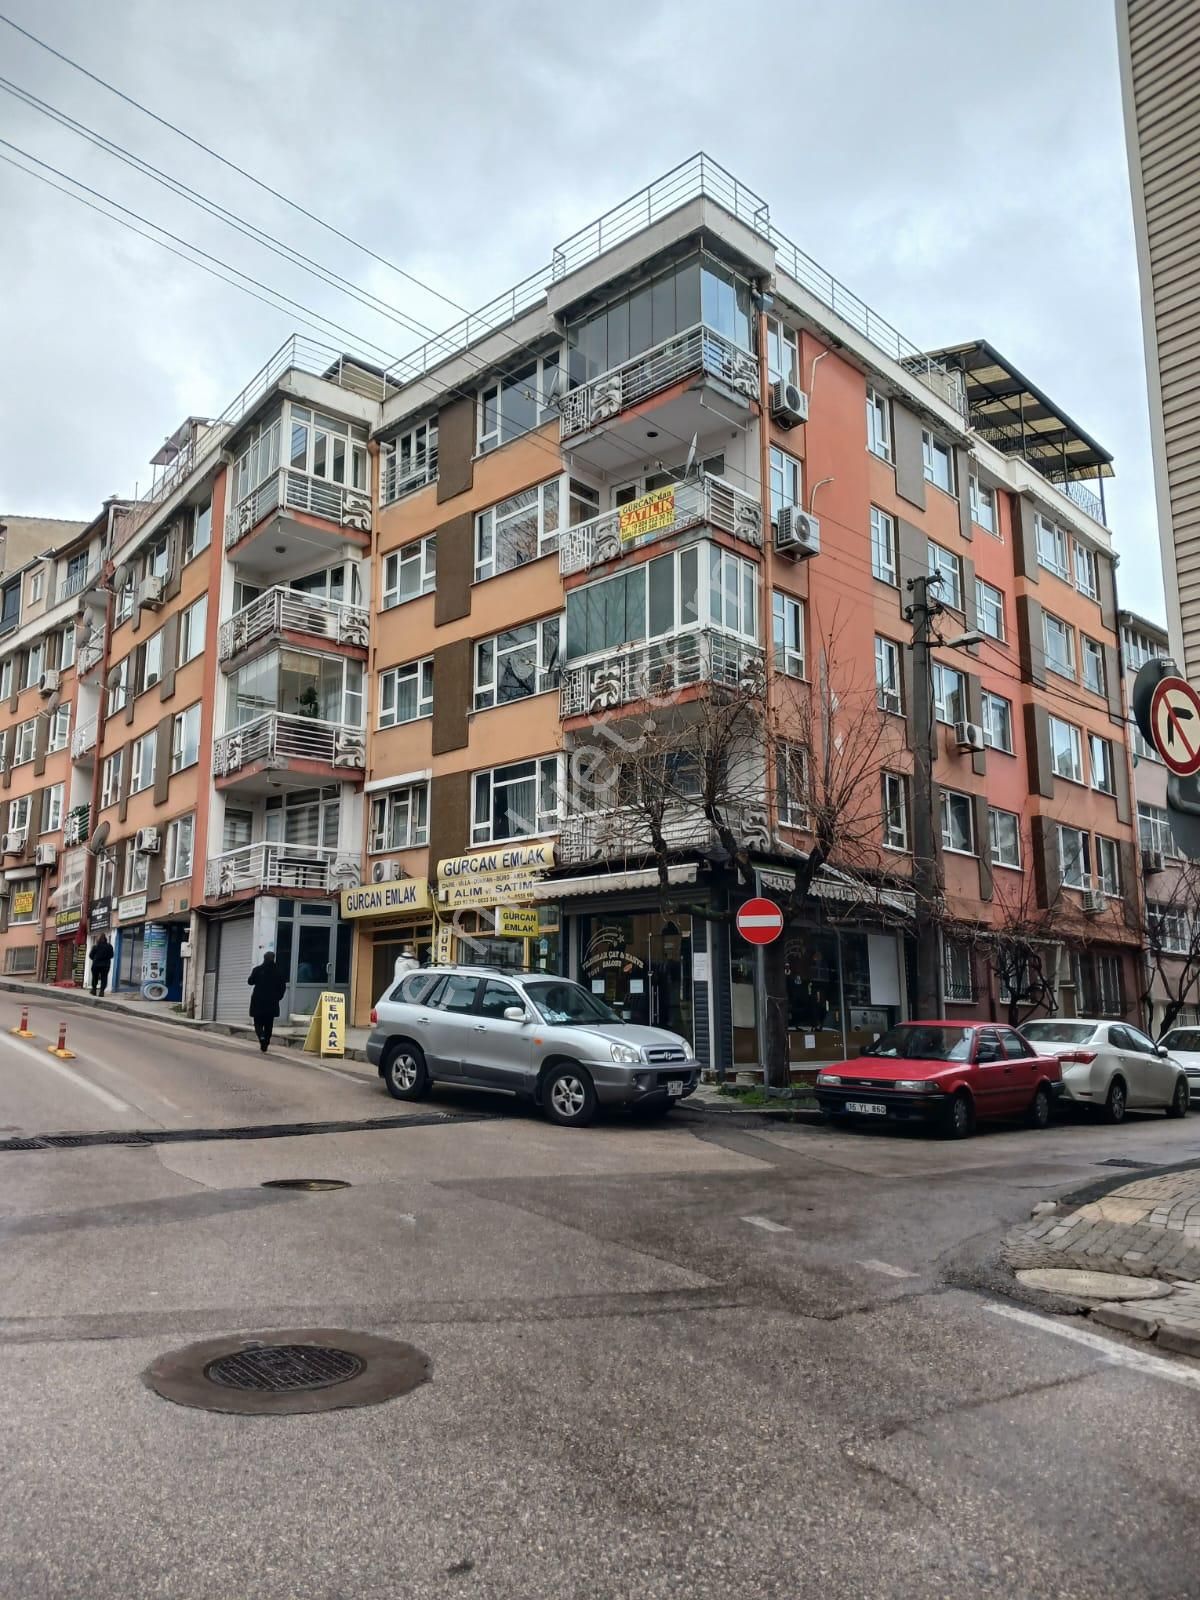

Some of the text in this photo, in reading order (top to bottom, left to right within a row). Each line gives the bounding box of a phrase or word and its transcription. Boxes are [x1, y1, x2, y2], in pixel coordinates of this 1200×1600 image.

[620, 497, 674, 527] SATILIK
[443, 847, 545, 876] GÜRCAN EMLAK
[346, 885, 417, 911] GÜRCAN EMLAK
[454, 886, 483, 898] ALIM
[495, 881, 533, 893] SATIM
[502, 911, 537, 922] GÜRCAN
[504, 923, 534, 932] EMLAK
[328, 1004, 339, 1047] EMLAK
